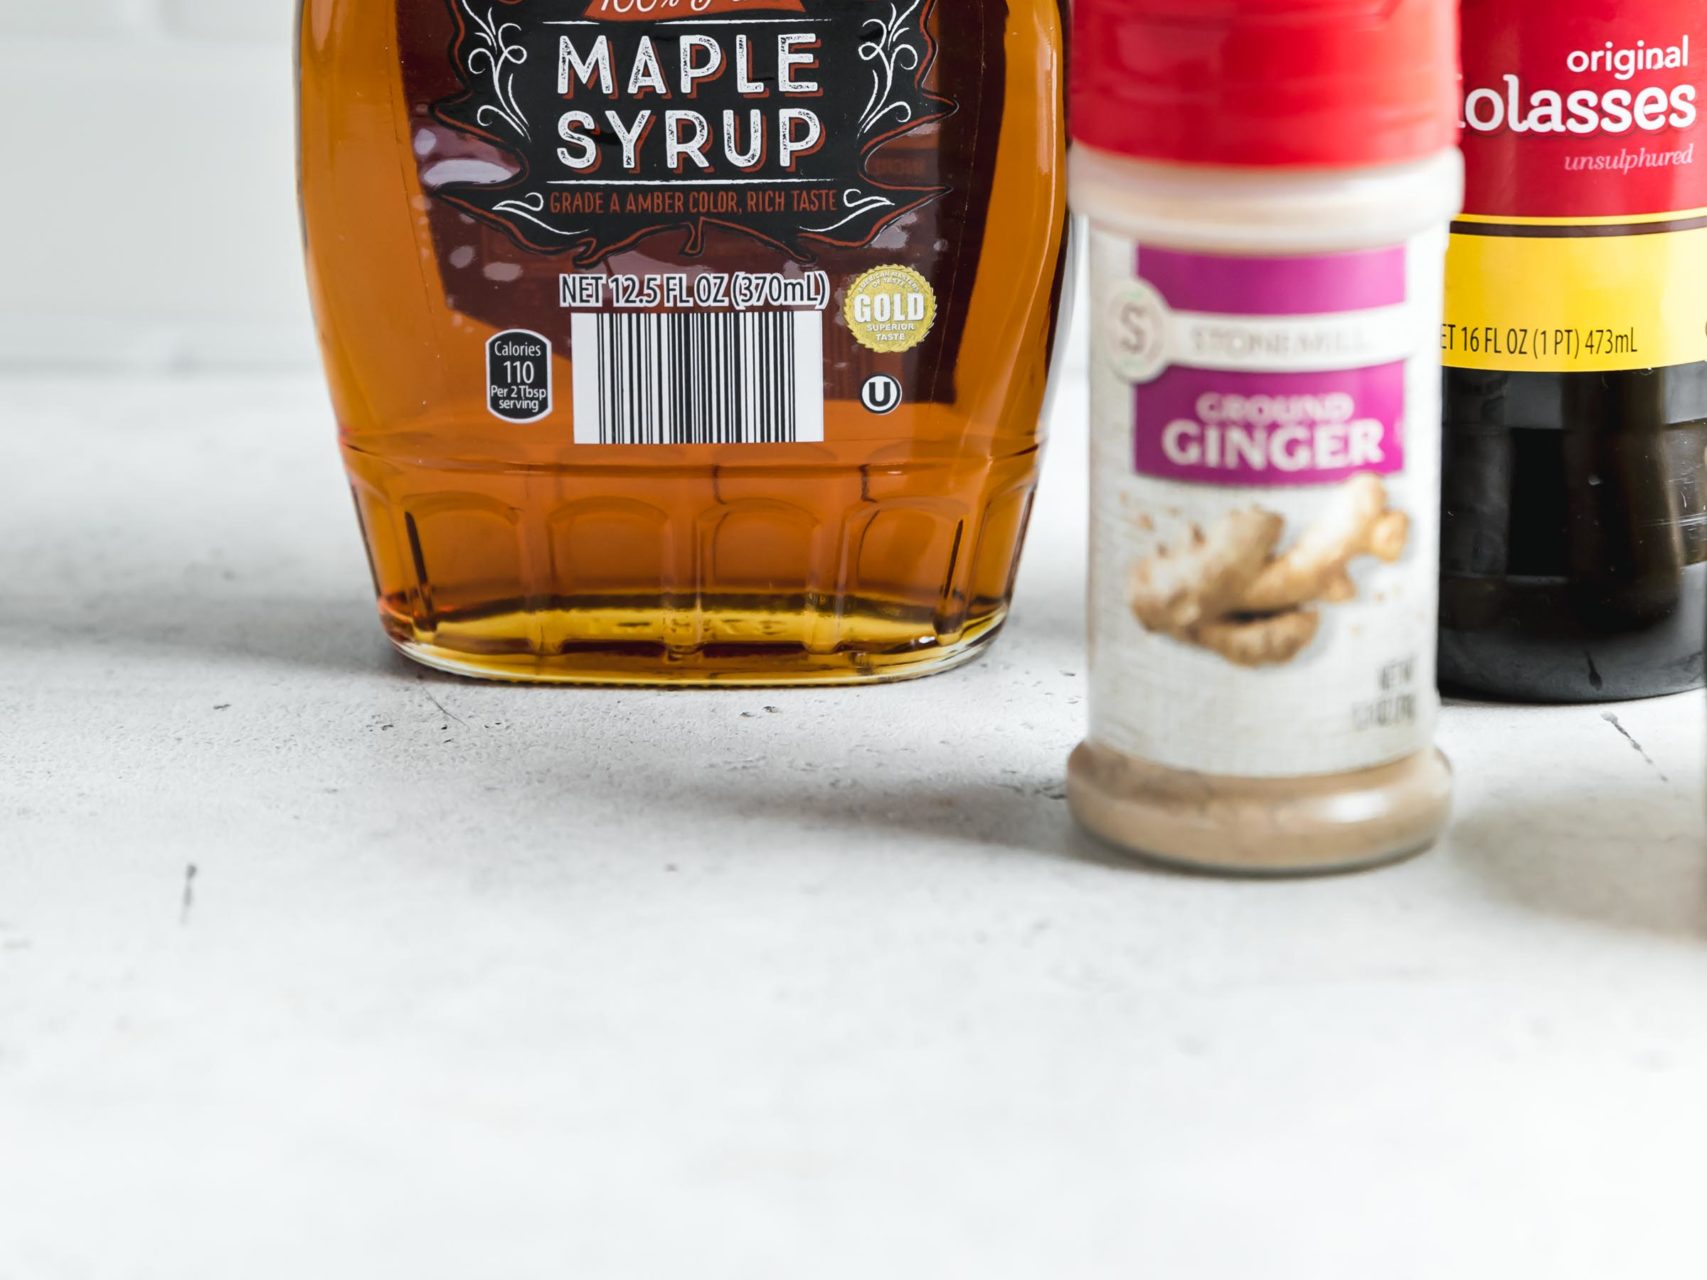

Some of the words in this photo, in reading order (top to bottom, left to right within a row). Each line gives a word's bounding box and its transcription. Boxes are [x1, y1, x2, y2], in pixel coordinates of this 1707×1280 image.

[558, 33, 821, 97] MAPLE
[1566, 34, 1689, 80] original
[1457, 74, 1697, 133] olasses
[558, 108, 823, 170] SYRUP
[1564, 142, 1694, 175] unsulphured
[550, 192, 604, 214] GRADE
[609, 192, 621, 214] A
[626, 190, 685, 214] AMBER
[689, 191, 743, 215] COLOR,
[747, 190, 785, 212] RICH
[791, 189, 838, 212] TASTE
[560, 274, 606, 306] NET
[609, 275, 661, 306] 12.5
[664, 274, 693, 306] FL
[696, 273, 728, 305] OZ
[731, 270, 830, 308] (370mL)
[853, 292, 925, 323] GOLD
[866, 323, 915, 332] SUPERIOR
[876, 333, 905, 341] TASTE
[1440, 323, 1456, 350] ET
[1461, 325, 1480, 352] 16
[1484, 327, 1501, 354] FL
[1507, 328, 1527, 354] OZ
[1533, 328, 1547, 359] (1
[1554, 328, 1580, 359] PT)
[1585, 327, 1638, 355] 473mL
[494, 341, 541, 356] Calories
[503, 361, 535, 384] 110
[491, 385, 508, 397] Per
[511, 385, 518, 398] 2
[519, 385, 547, 400] Tbsp
[499, 397, 539, 413] serving
[1196, 392, 1354, 422] GROUND
[1162, 418, 1385, 472] GINGER
